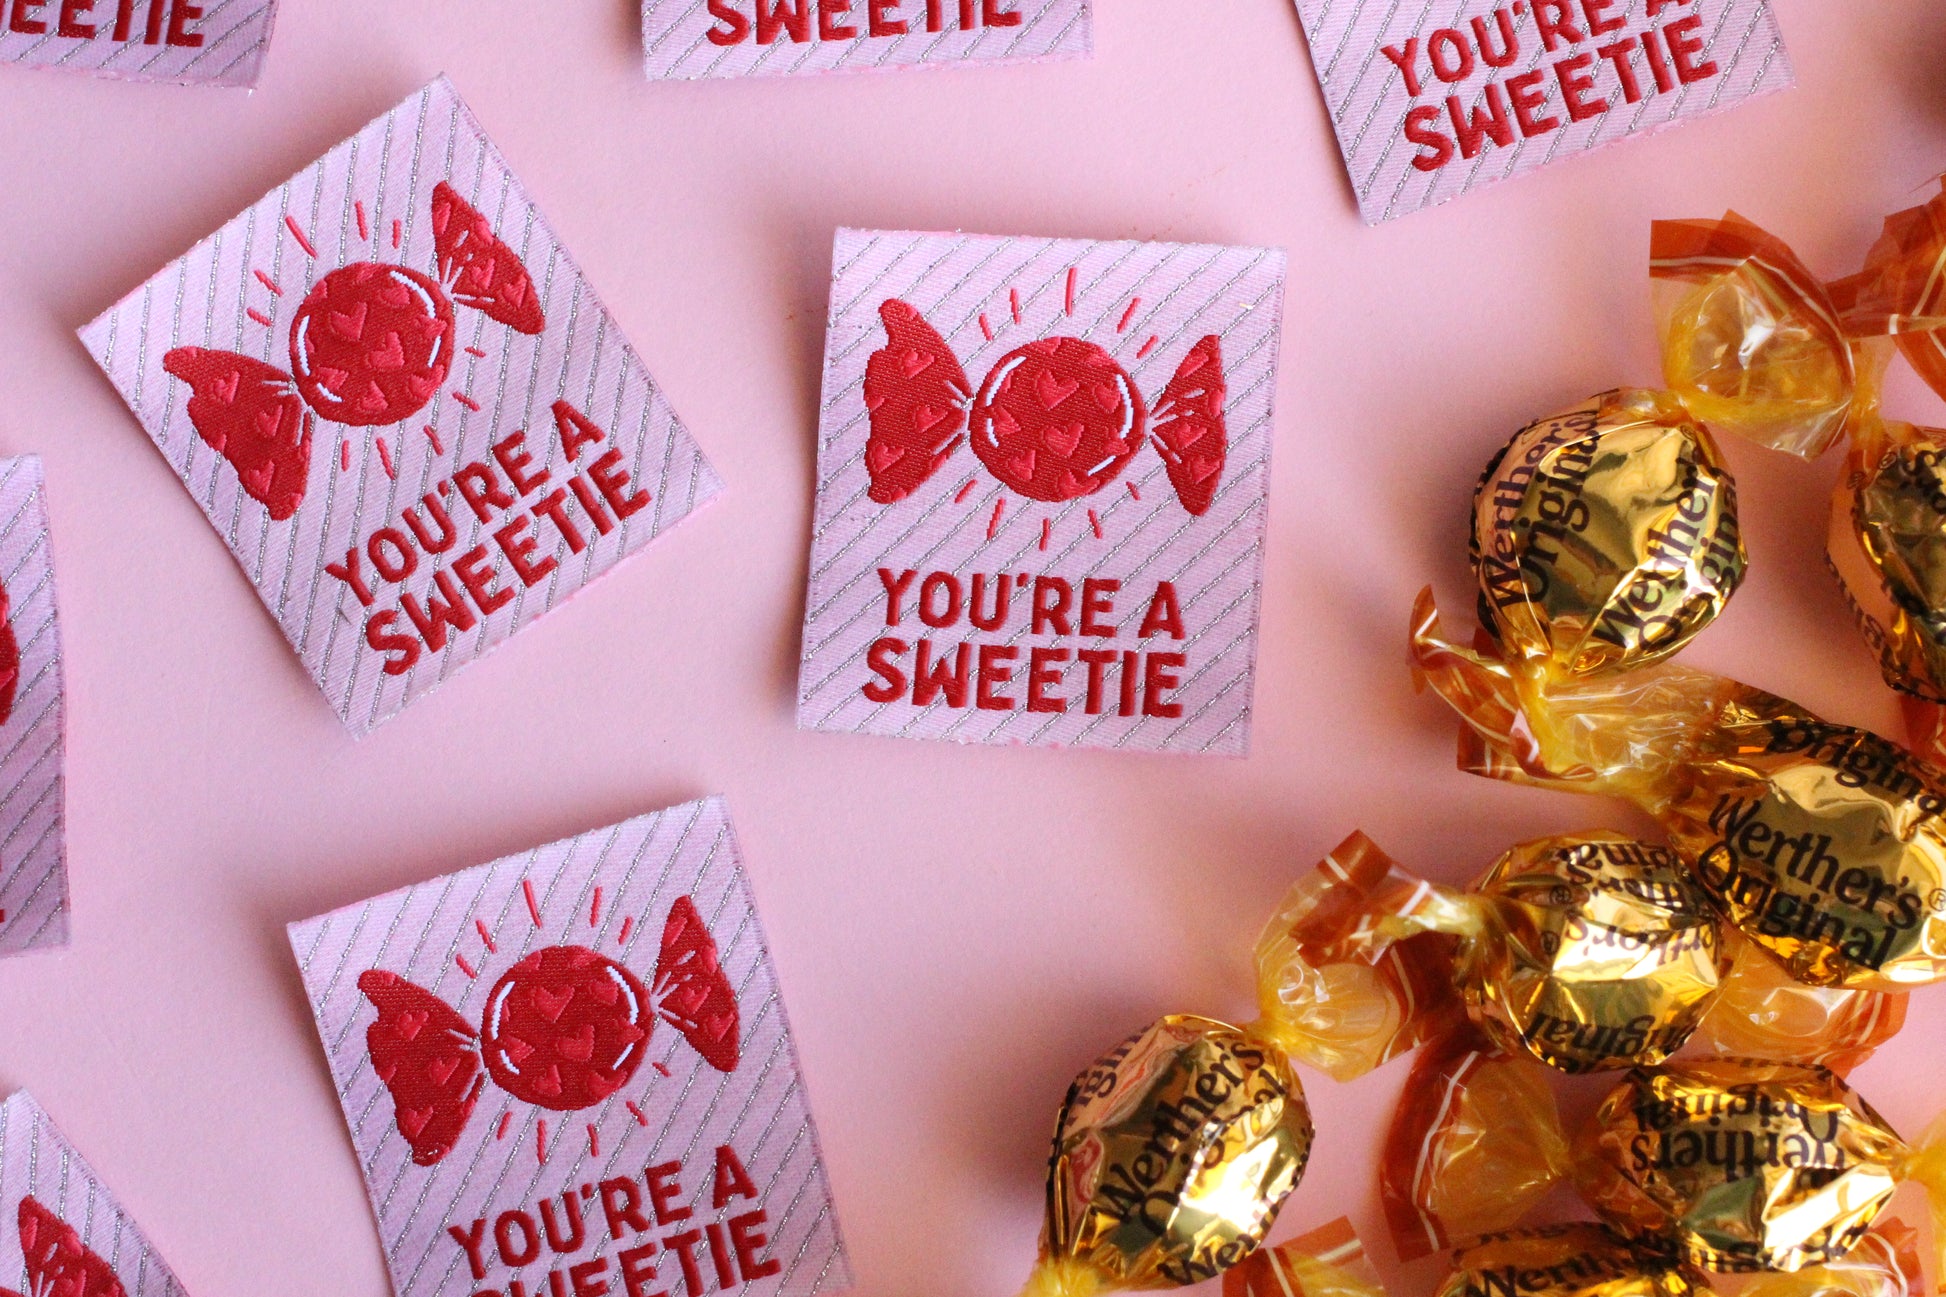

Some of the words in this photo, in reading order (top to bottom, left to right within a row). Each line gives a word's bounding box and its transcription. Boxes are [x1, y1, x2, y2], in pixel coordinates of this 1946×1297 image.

[0, 0, 203, 47] EETIE
[1403, 14, 1718, 172] SWEETIE
[324, 430, 550, 607] YOU'RE
[552, 400, 605, 462] A
[364, 447, 651, 676] SWEETIE
[877, 568, 1121, 638] YOU'RE
[1137, 581, 1185, 640] A
[861, 637, 1186, 719] SWEETIE
[1699, 841, 1897, 971] Original
[1708, 793, 1912, 930] Werther's
[1089, 1040, 1266, 1224] Werther's
[447, 1160, 694, 1280] YOU'RE
[712, 1144, 758, 1210] A
[472, 1209, 782, 1297] EETIE
